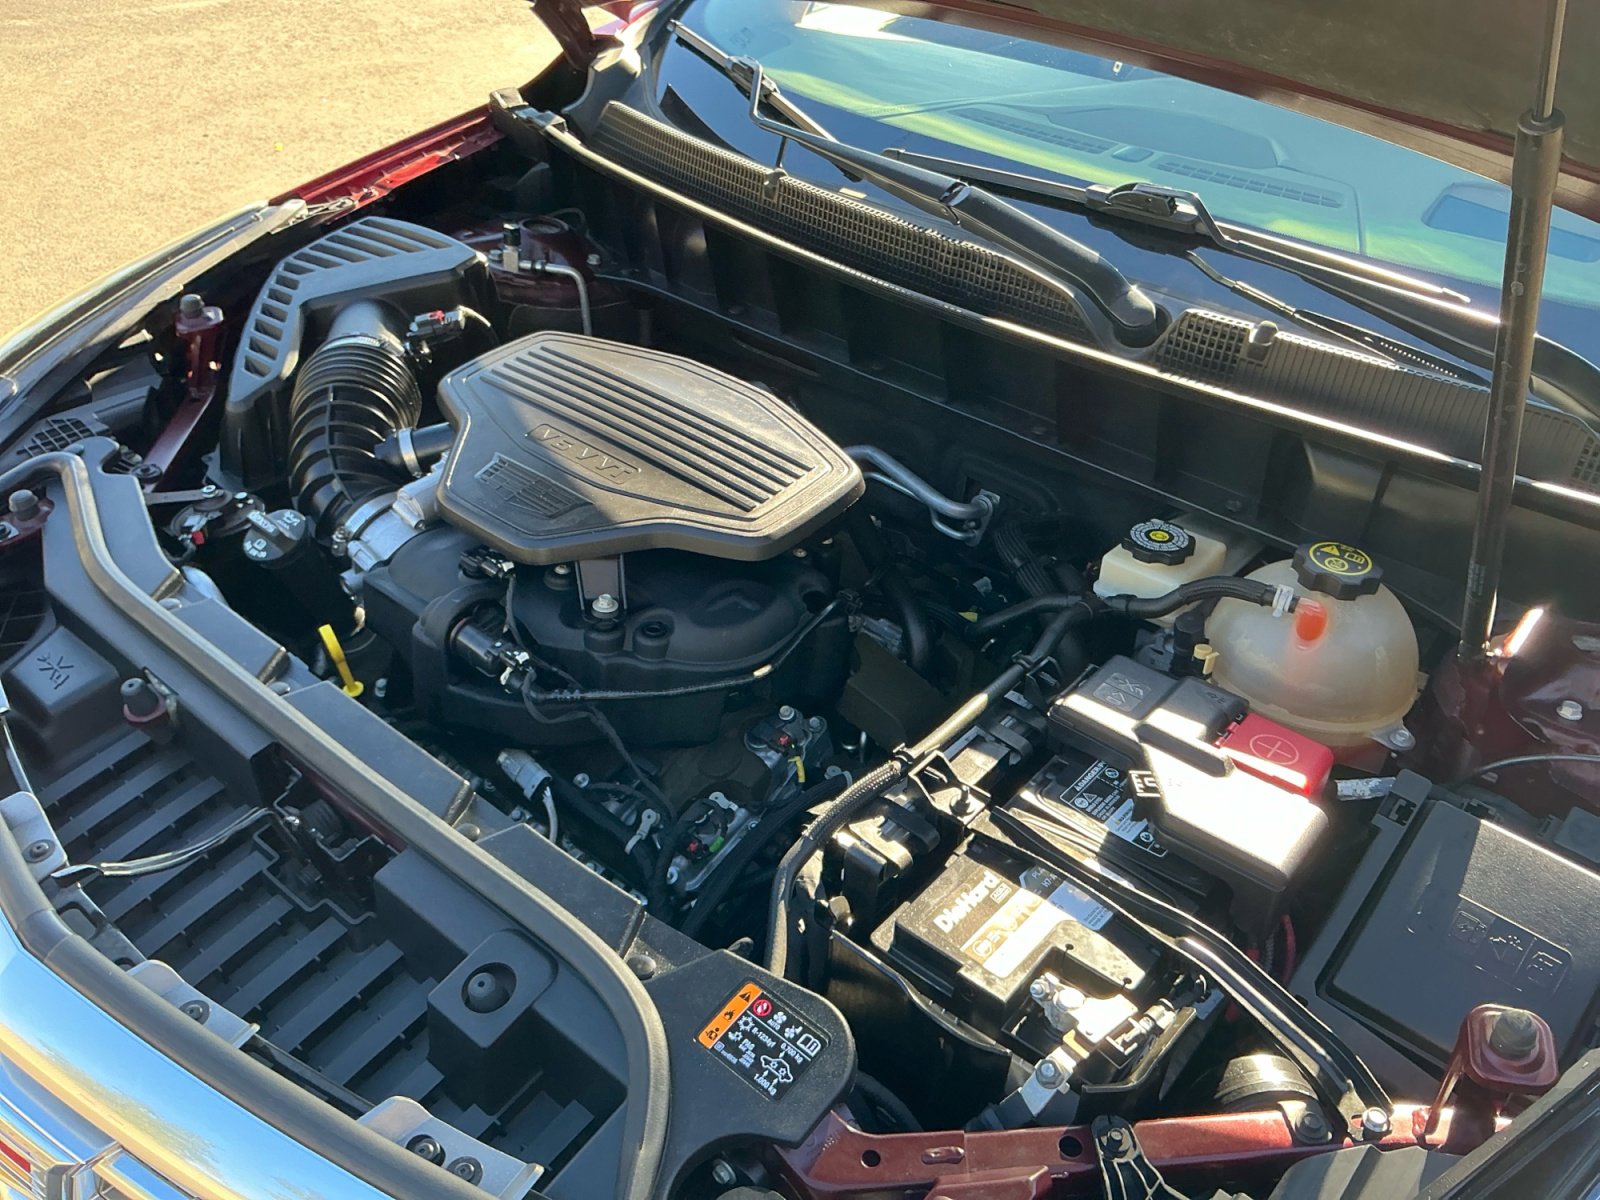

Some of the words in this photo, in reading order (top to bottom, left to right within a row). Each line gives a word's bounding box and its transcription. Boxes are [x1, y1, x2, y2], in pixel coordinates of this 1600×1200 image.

[933, 869, 1001, 934] DieHard
[793, 1053, 803, 1063] kg
[752, 1073, 769, 1088] 1.000
